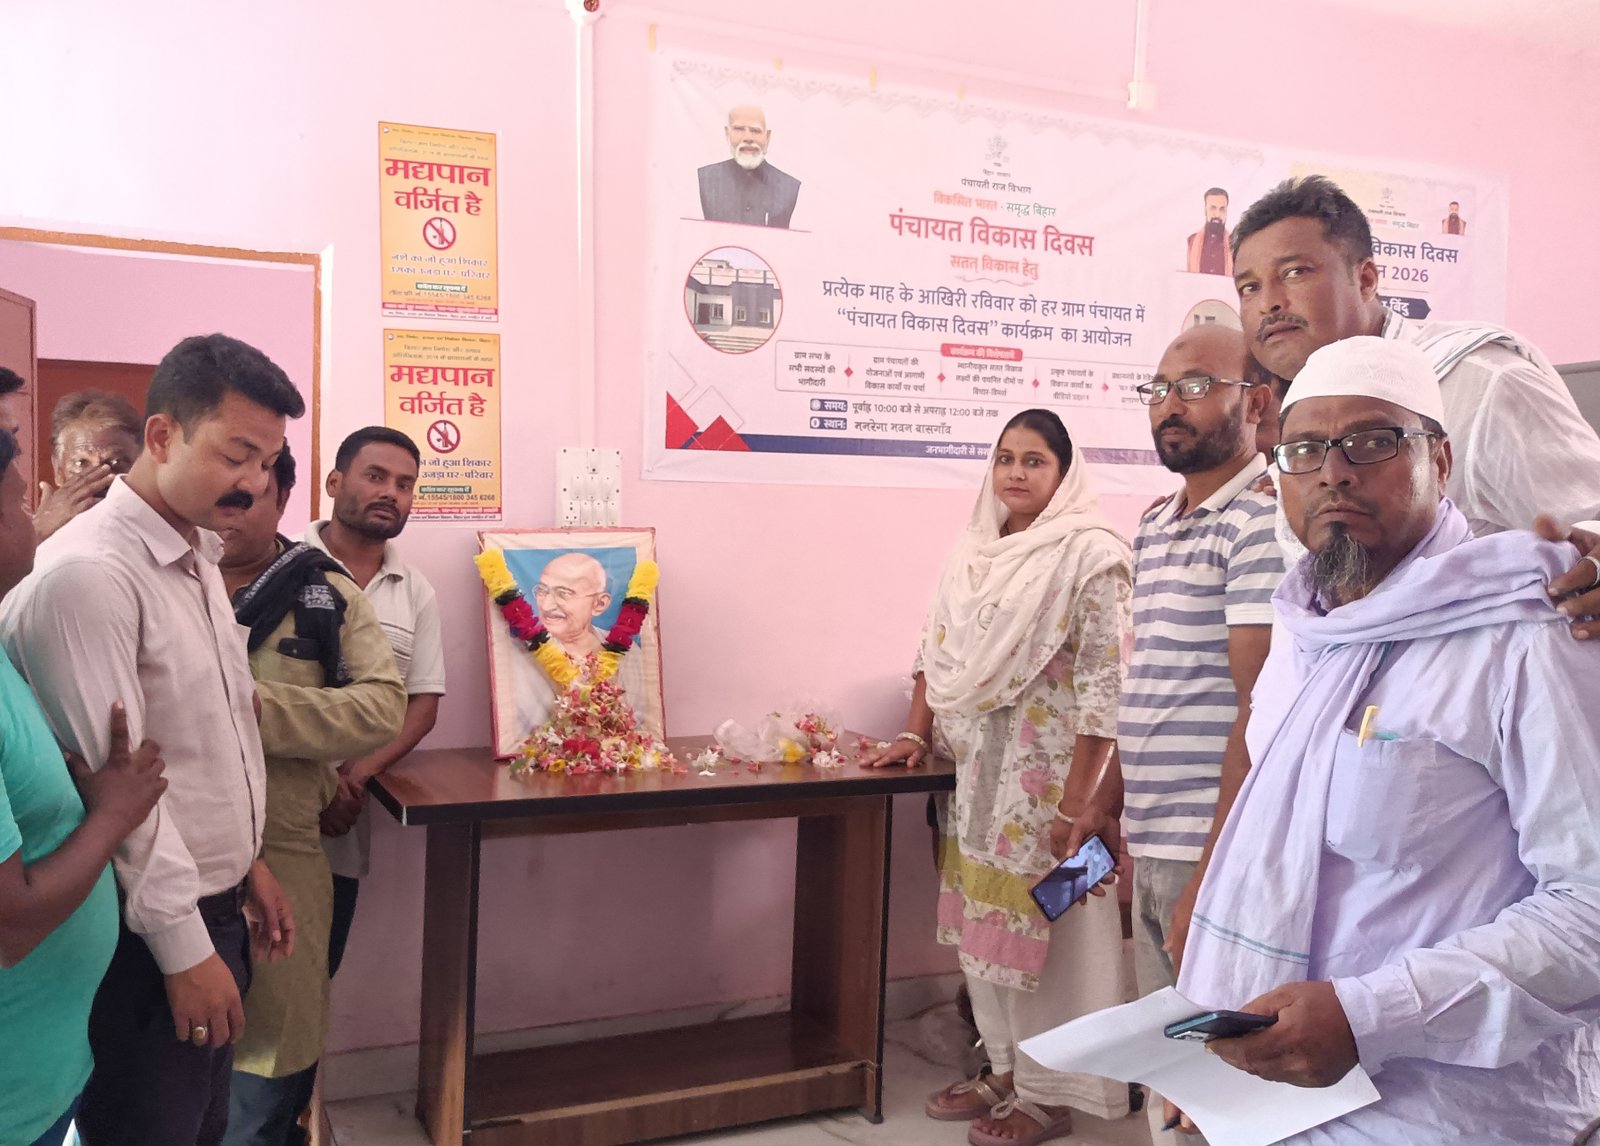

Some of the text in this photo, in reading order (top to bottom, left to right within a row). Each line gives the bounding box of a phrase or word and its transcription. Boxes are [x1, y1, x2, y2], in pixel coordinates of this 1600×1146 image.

[384, 158, 492, 186] मद्यपान
[961, 178, 1032, 194] पंचायती राज विभाग
[394, 186, 483, 216] वर्जित है
[933, 190, 972, 208] विकसित
[975, 198, 998, 210] भारत
[1006, 202, 1030, 218] समृद्ध
[1032, 203, 1056, 218] बिहार
[889, 208, 1094, 256] पंचायत विकास दिवस
[1420, 242, 1459, 263] दिवस
[950, 254, 1040, 280] सतत् विकास हेतु
[1392, 266, 1429, 282] 2026
[822, 276, 1146, 322] प्रत्येक माह के आखिरी रविवार को हर ग्राम पंचायत में
[838, 306, 1132, 346] “पंचायत विकास दिवस” कार्यक्रम का आयोजन
[389, 364, 496, 388] मद्यपान
[827, 365, 836, 374] की
[398, 390, 488, 417] वर्जित है
[874, 404, 897, 414] 10:00
[900, 402, 912, 414] बजे
[914, 404, 921, 414] से
[949, 407, 970, 417] 12:00
[972, 406, 984, 418] बजे
[985, 409, 999, 418] तक
[854, 418, 888, 433] मनरेगा
[969, 445, 976, 455] से
[428, 457, 440, 466] जो
[442, 459, 460, 469] हुआ
[462, 458, 492, 467] शिकार
